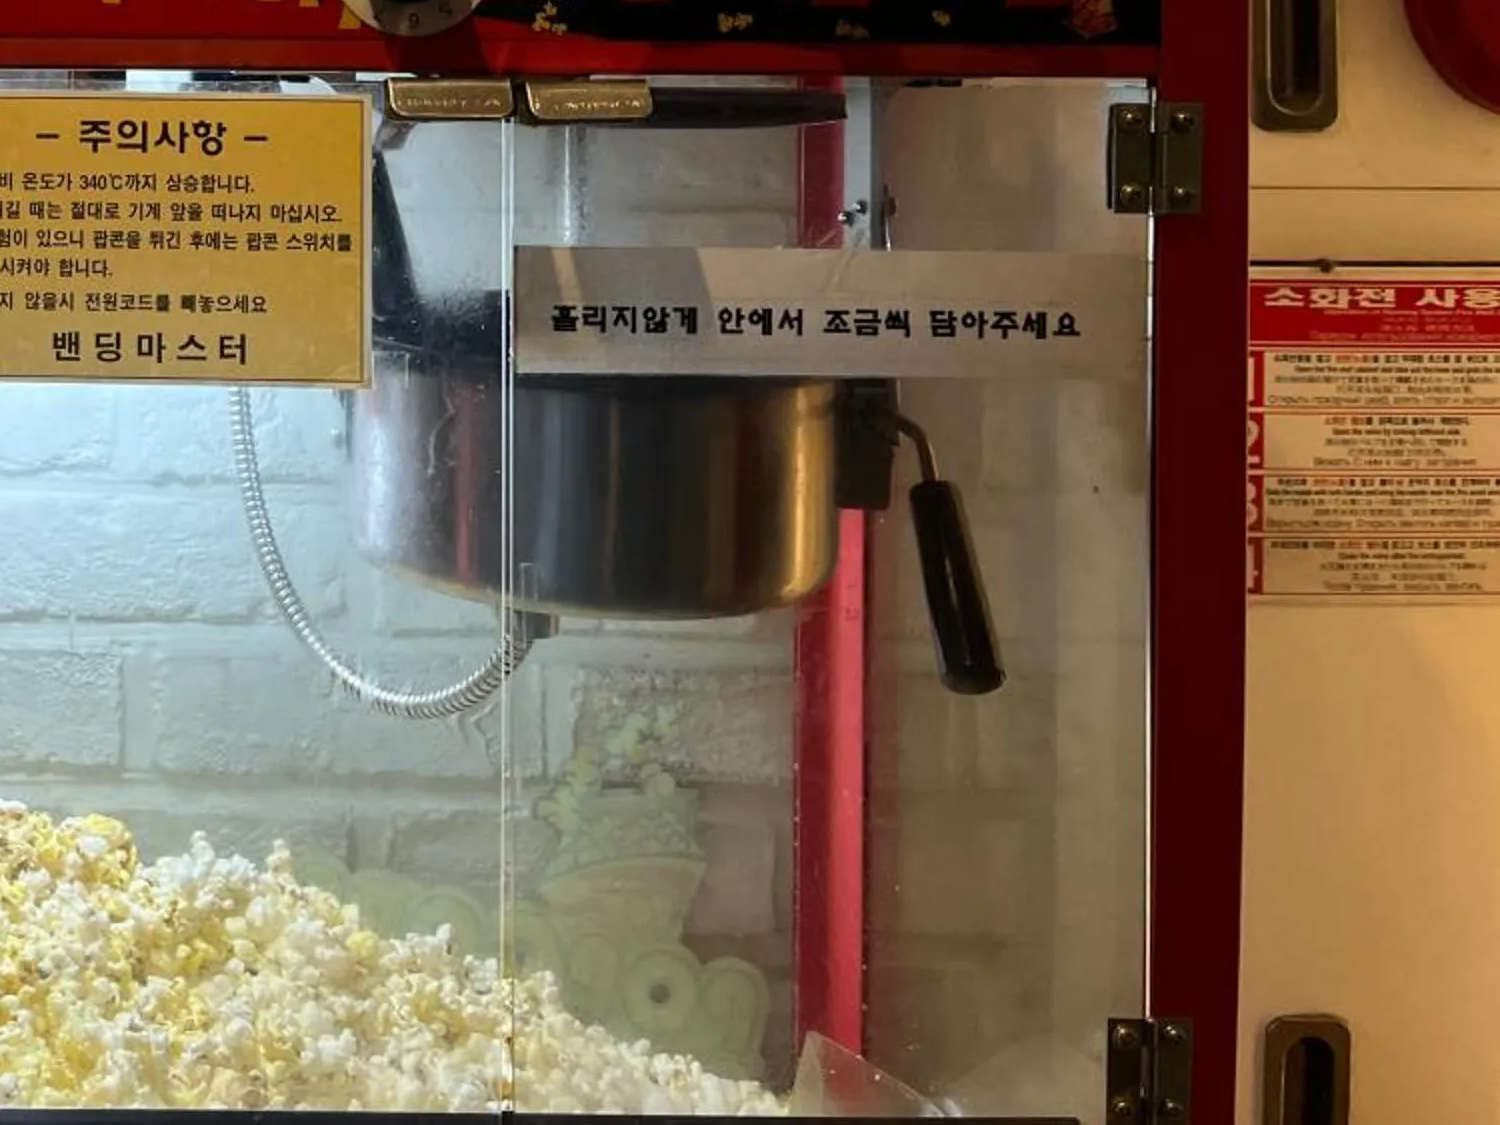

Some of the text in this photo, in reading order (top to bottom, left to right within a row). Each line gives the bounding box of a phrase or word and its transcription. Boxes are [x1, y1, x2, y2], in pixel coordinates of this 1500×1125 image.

[78, 119, 228, 157] 주의사항
[21, 172, 73, 192] 온도가
[28, 200, 63, 220] 때는
[71, 201, 121, 220] 절대로
[129, 202, 161, 221] 기계
[169, 202, 203, 222] 앞을
[35, 229, 84, 249] 있으니
[93, 230, 141, 250] 팝콘을
[148, 230, 182, 251] 튀긴
[188, 231, 239, 252] 후에는
[246, 231, 279, 252] 팝콘
[285, 232, 352, 253] 스위치를
[0, 258, 50, 277] 시켜야
[58, 258, 113, 278] 합니다.
[24, 292, 75, 312] 않을시
[84, 292, 171, 314] 전원코드를
[1263, 286, 1397, 309] 소화전
[718, 307, 804, 337] 안에서
[822, 308, 911, 338] 조금씩
[929, 310, 1081, 340] 담아주세요
